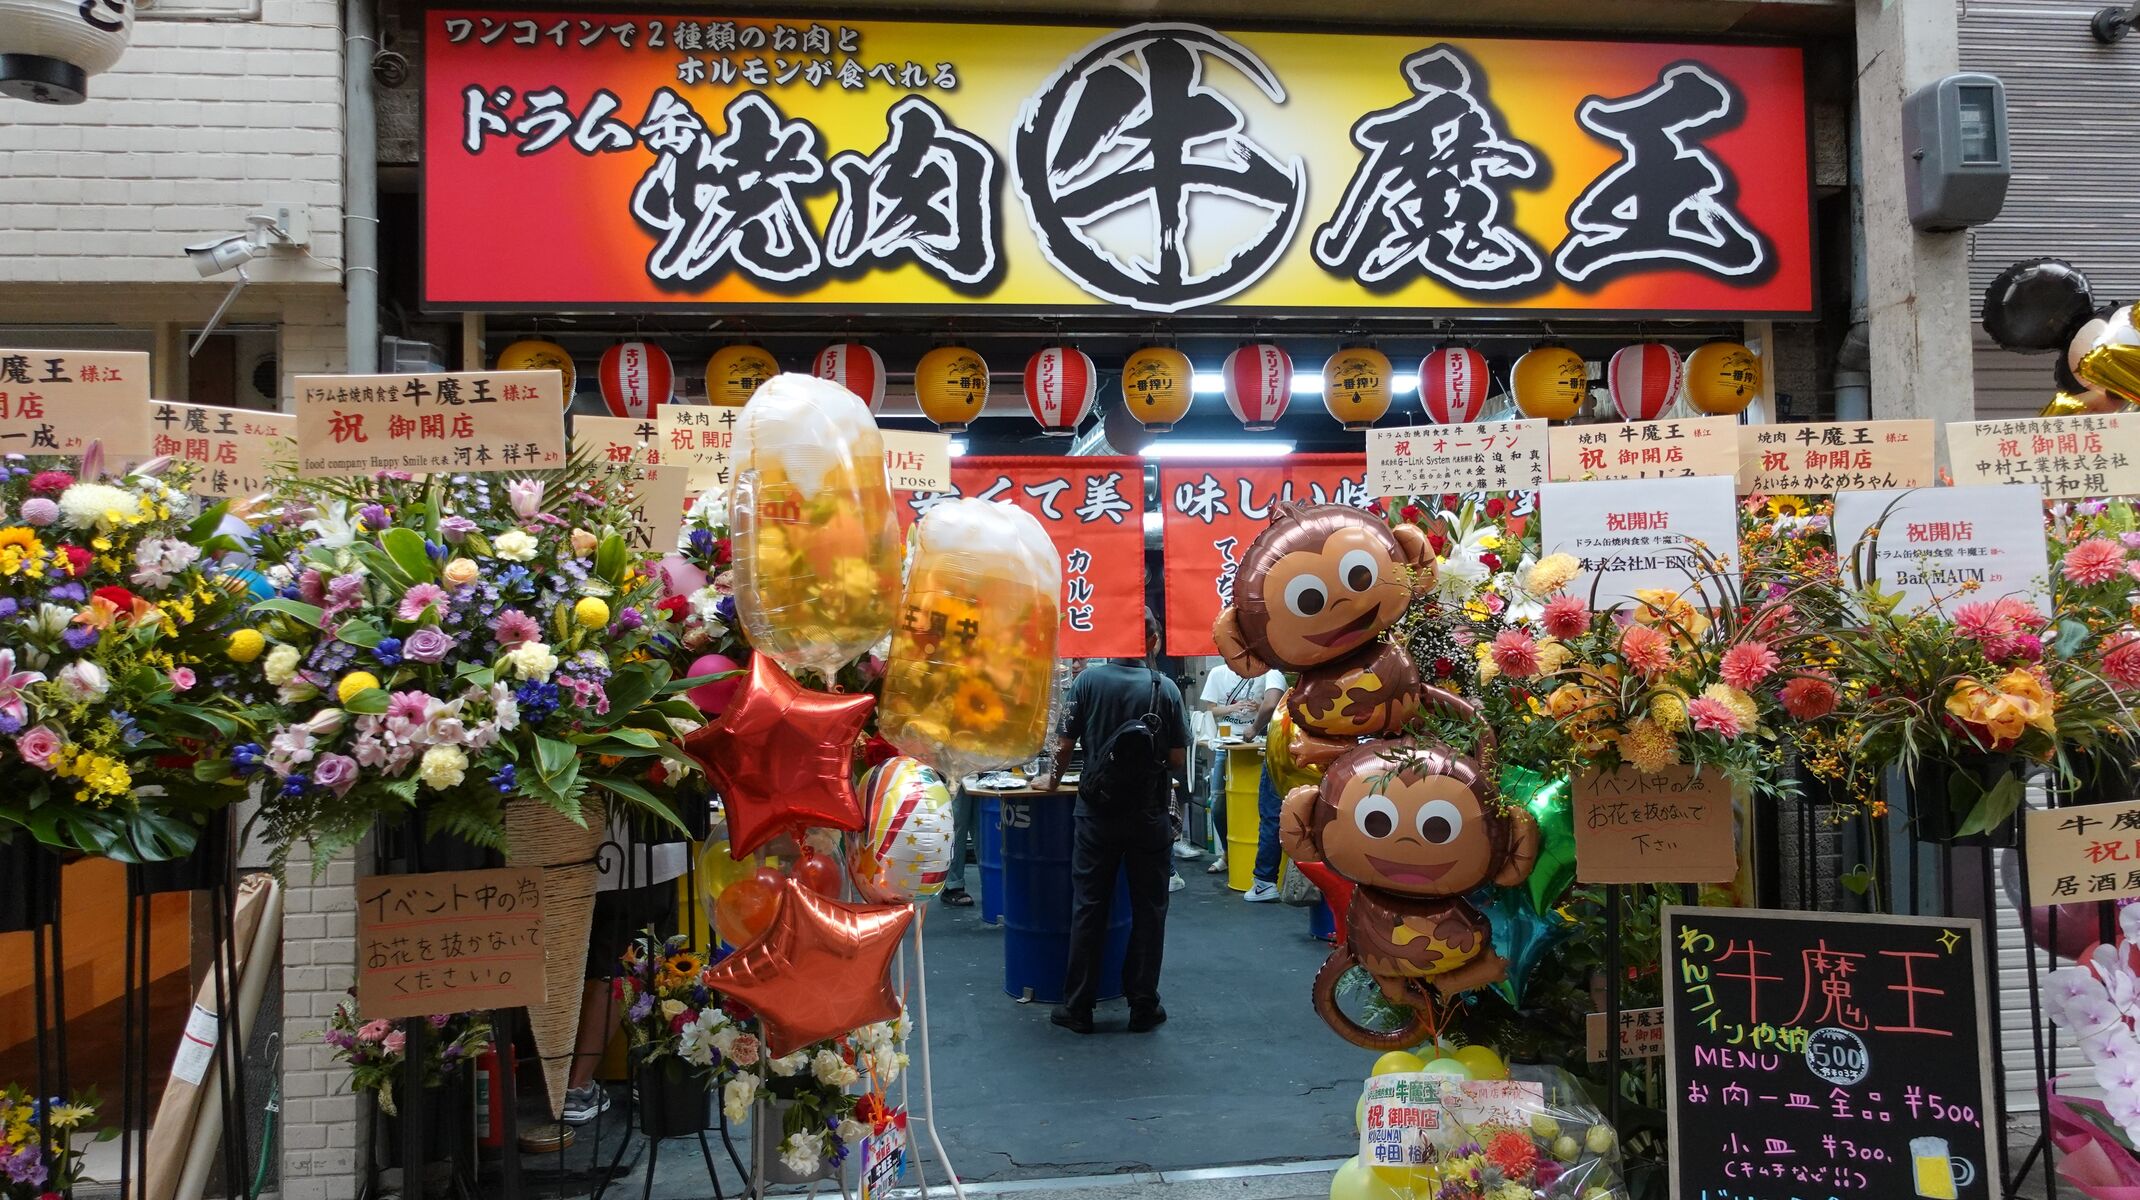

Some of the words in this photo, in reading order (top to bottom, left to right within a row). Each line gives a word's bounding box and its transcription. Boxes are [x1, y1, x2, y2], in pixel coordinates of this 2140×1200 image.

[677, 56, 959, 90] ホルモンが食べれる
[626, 348, 643, 407] キリンビール
[947, 376, 987, 391] 一番搾り
[1042, 354, 1057, 411] キリンビール
[1128, 377, 1172, 391] 一番搾り
[1264, 349, 1280, 406] キリンビール
[1333, 377, 1379, 390] 一番搾り
[1449, 352, 1464, 409] キリンビール
[305, 385, 400, 404] ドラム缶焼肉食堂
[402, 377, 499, 407] 牛魔王
[503, 384, 540, 402] 様江
[154, 404, 239, 436] 牛魔王
[328, 409, 369, 444] 祝
[388, 412, 475, 441] 御開店
[677, 411, 709, 426] 焼肉
[671, 428, 695, 450] 祝
[1394, 440, 1411, 457] 祝
[1433, 434, 1519, 454] オープン
[1579, 432, 1607, 444] 焼肉
[1618, 423, 1685, 443] 牛魔王
[1757, 431, 1786, 444] 焼肉
[1795, 426, 1874, 447] 牛魔王
[1997, 437, 2022, 458] 祝
[2031, 432, 2104, 456] 御開店
[154, 434, 238, 465] 御開店
[605, 441, 633, 463] 祝
[1579, 447, 1607, 469] 祝
[1617, 445, 1684, 466] 御開店
[1761, 449, 1790, 472] 祝
[1805, 449, 1873, 471] 御開店
[305, 458, 325, 471] food
[327, 457, 368, 472] company
[370, 454, 401, 472] Happy
[403, 454, 428, 467] Smile
[1976, 451, 2130, 477] 中村工業株式会社
[1606, 510, 1669, 532] 祝開店
[1906, 520, 1973, 543] 祝開店
[1066, 548, 1095, 632] カルビ
[1631, 834, 1678, 855] 下さい
[365, 876, 540, 922] イベント中の為
[367, 919, 542, 970] お花を抜かないで
[1712, 938, 1953, 1037] 牛魔王
[1694, 1043, 1779, 1071] MENU
[1812, 1043, 1862, 1070] 500
[1367, 1104, 1385, 1130] 祝
